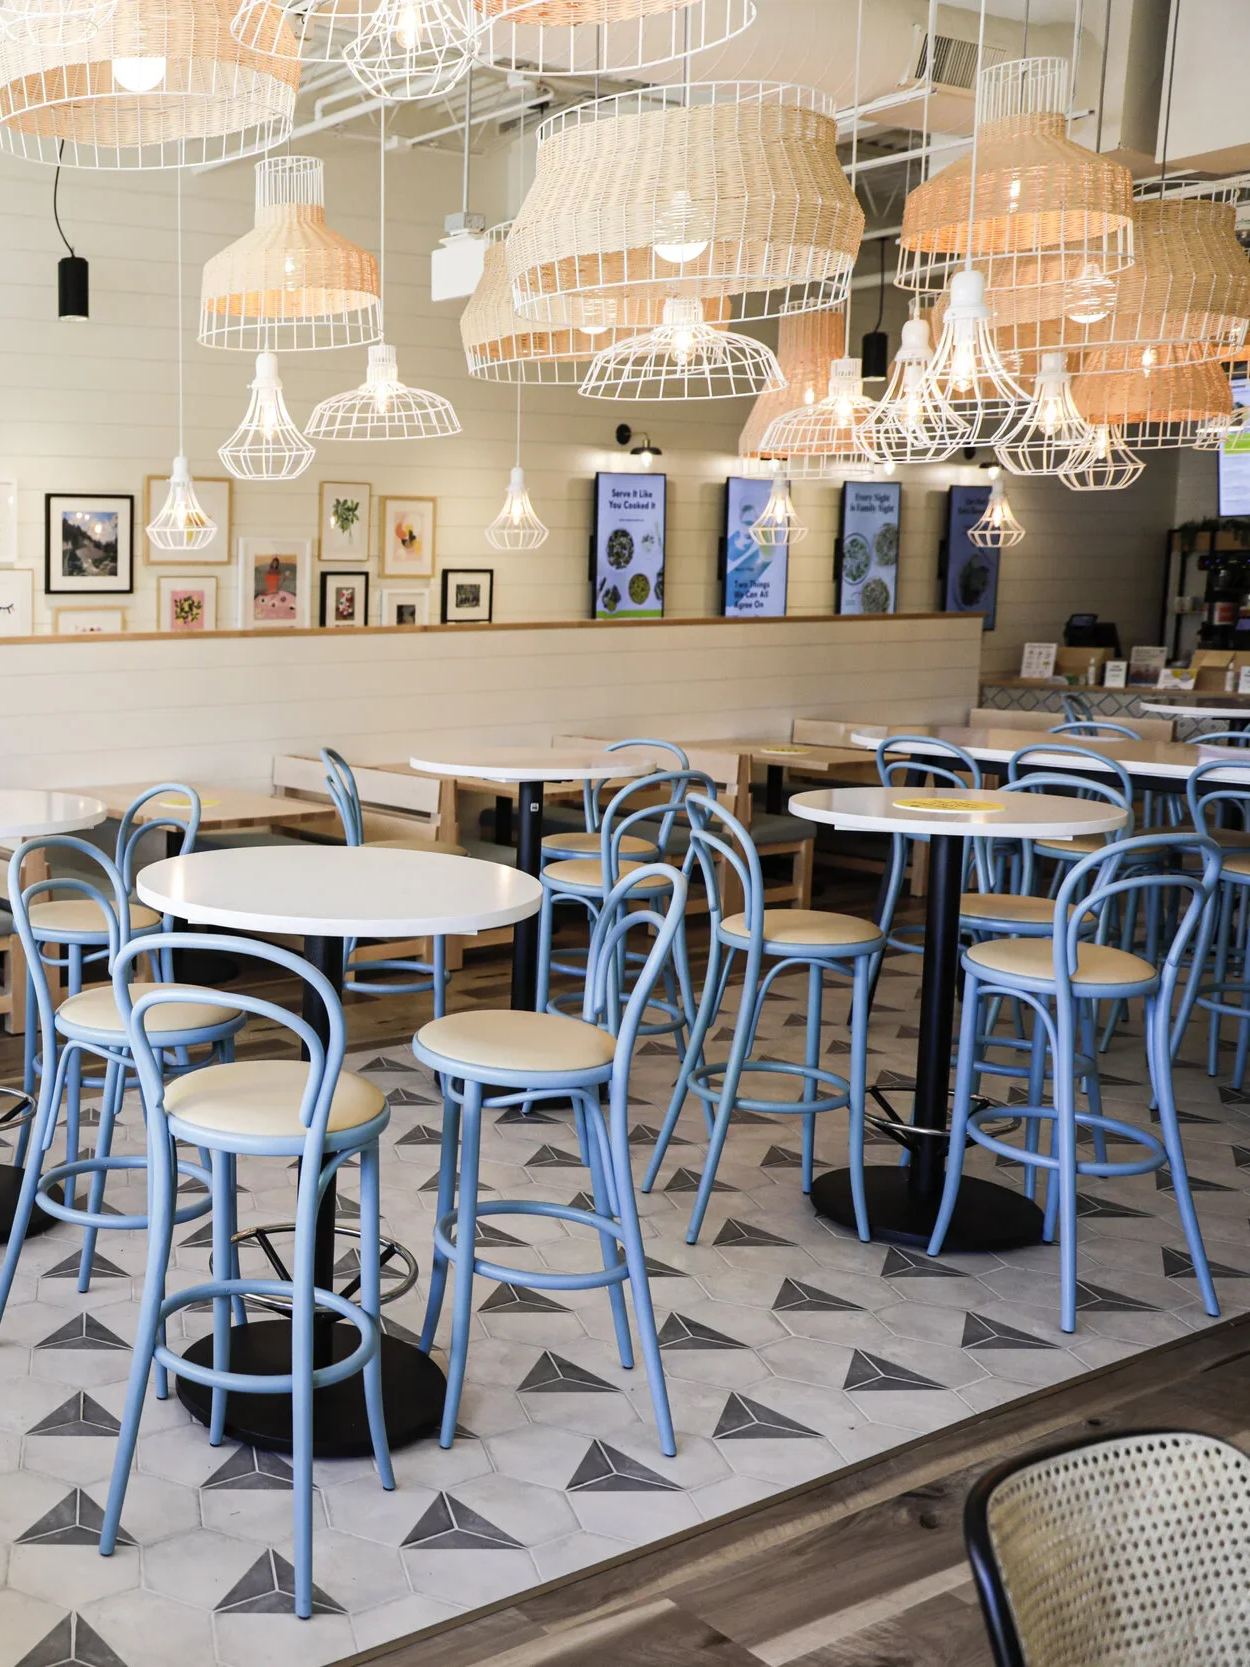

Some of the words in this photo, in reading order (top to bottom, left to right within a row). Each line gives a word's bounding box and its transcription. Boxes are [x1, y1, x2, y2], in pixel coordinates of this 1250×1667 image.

[612, 488, 631, 498] Serve
[639, 489, 653, 499] Like
[609, 499, 622, 509] You
[623, 500, 650, 510] Cooked
